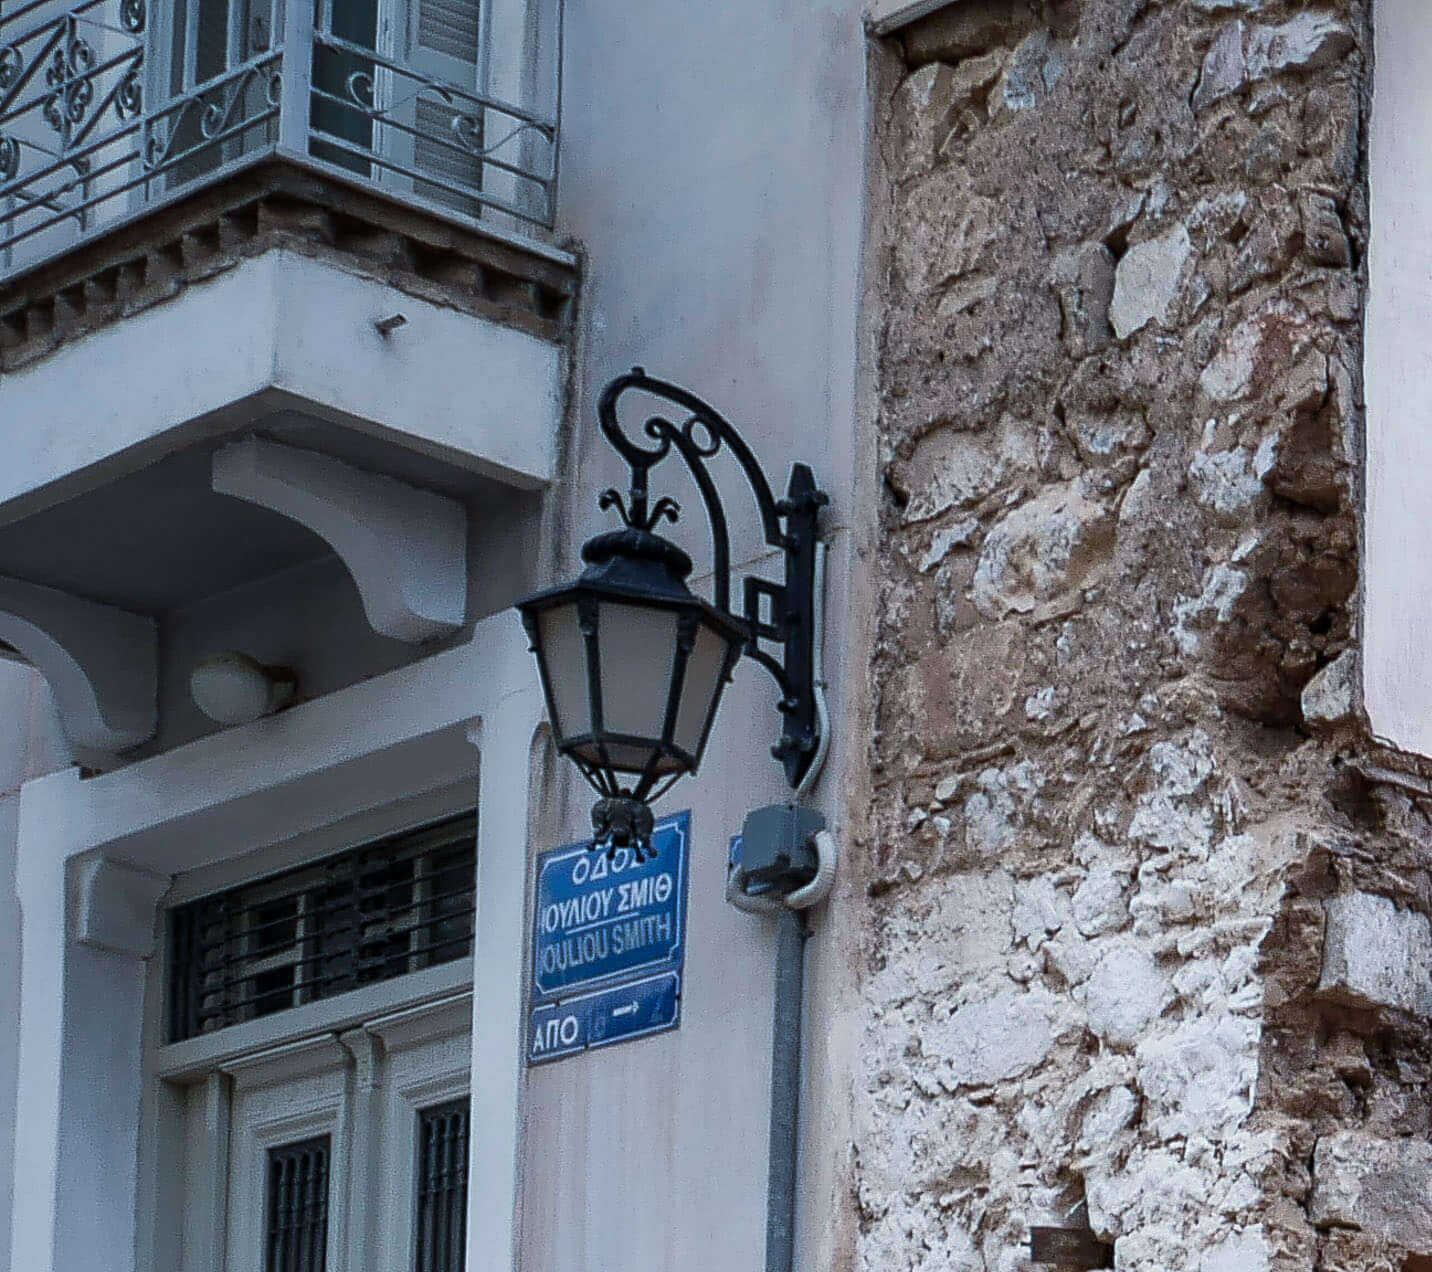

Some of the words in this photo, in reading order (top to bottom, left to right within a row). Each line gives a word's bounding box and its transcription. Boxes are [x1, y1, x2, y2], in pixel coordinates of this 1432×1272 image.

[541, 888, 614, 934] ΙΟΥΛΙΟΥ
[618, 873, 672, 912] ΣΜΙΘ
[540, 928, 608, 976] IOULIOU
[612, 912, 671, 954] SMITH
[532, 1015, 579, 1053] ΑΠΟ
